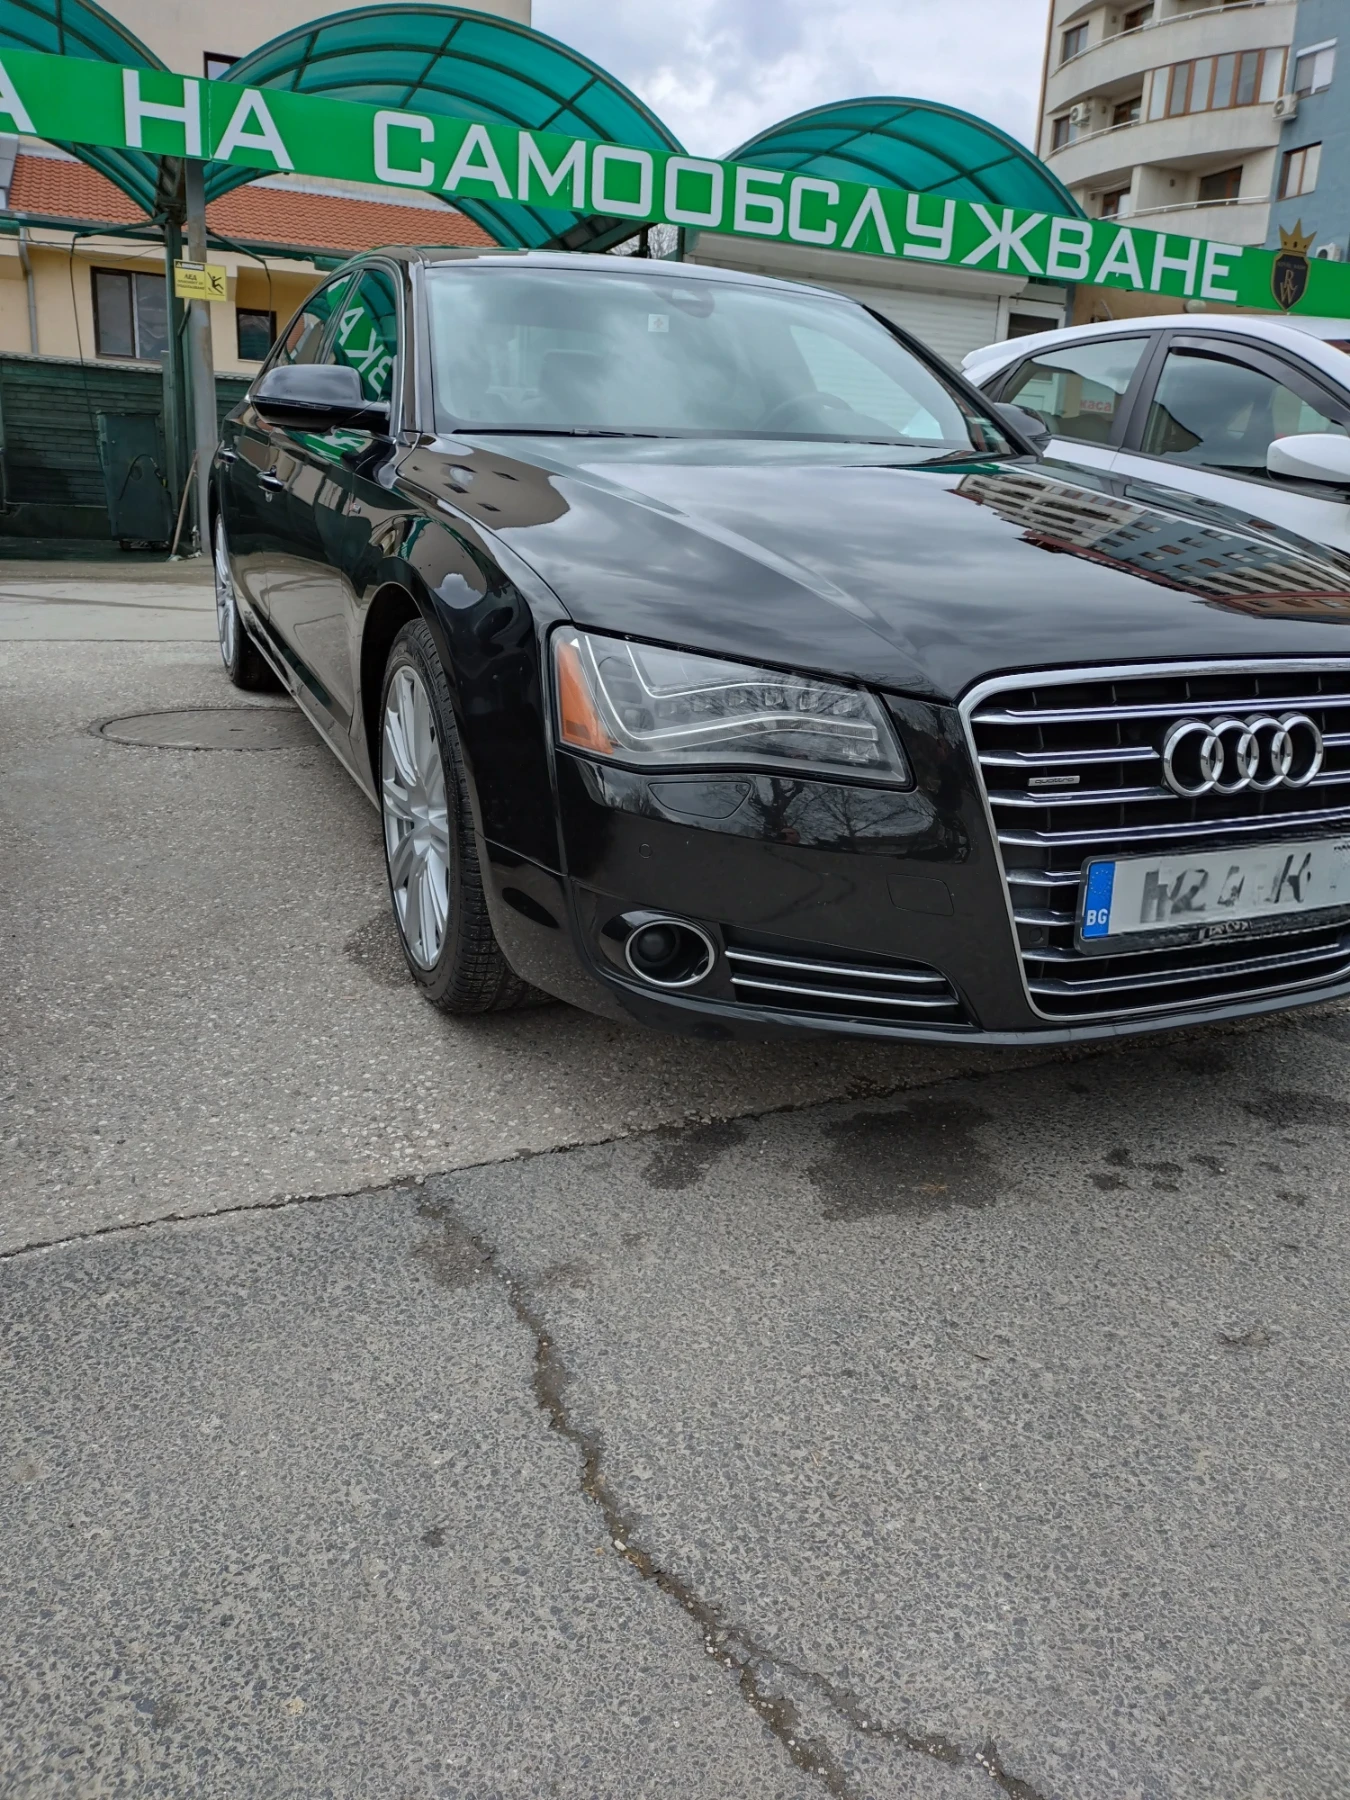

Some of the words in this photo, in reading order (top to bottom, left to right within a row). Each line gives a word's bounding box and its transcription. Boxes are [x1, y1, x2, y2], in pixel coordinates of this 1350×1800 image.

[122, 68, 295, 170] НА
[373, 110, 1243, 301] САМООБСЛУЖВАНЕ
[1035, 777, 1074, 785] quattro
[1086, 908, 1108, 926] BG
